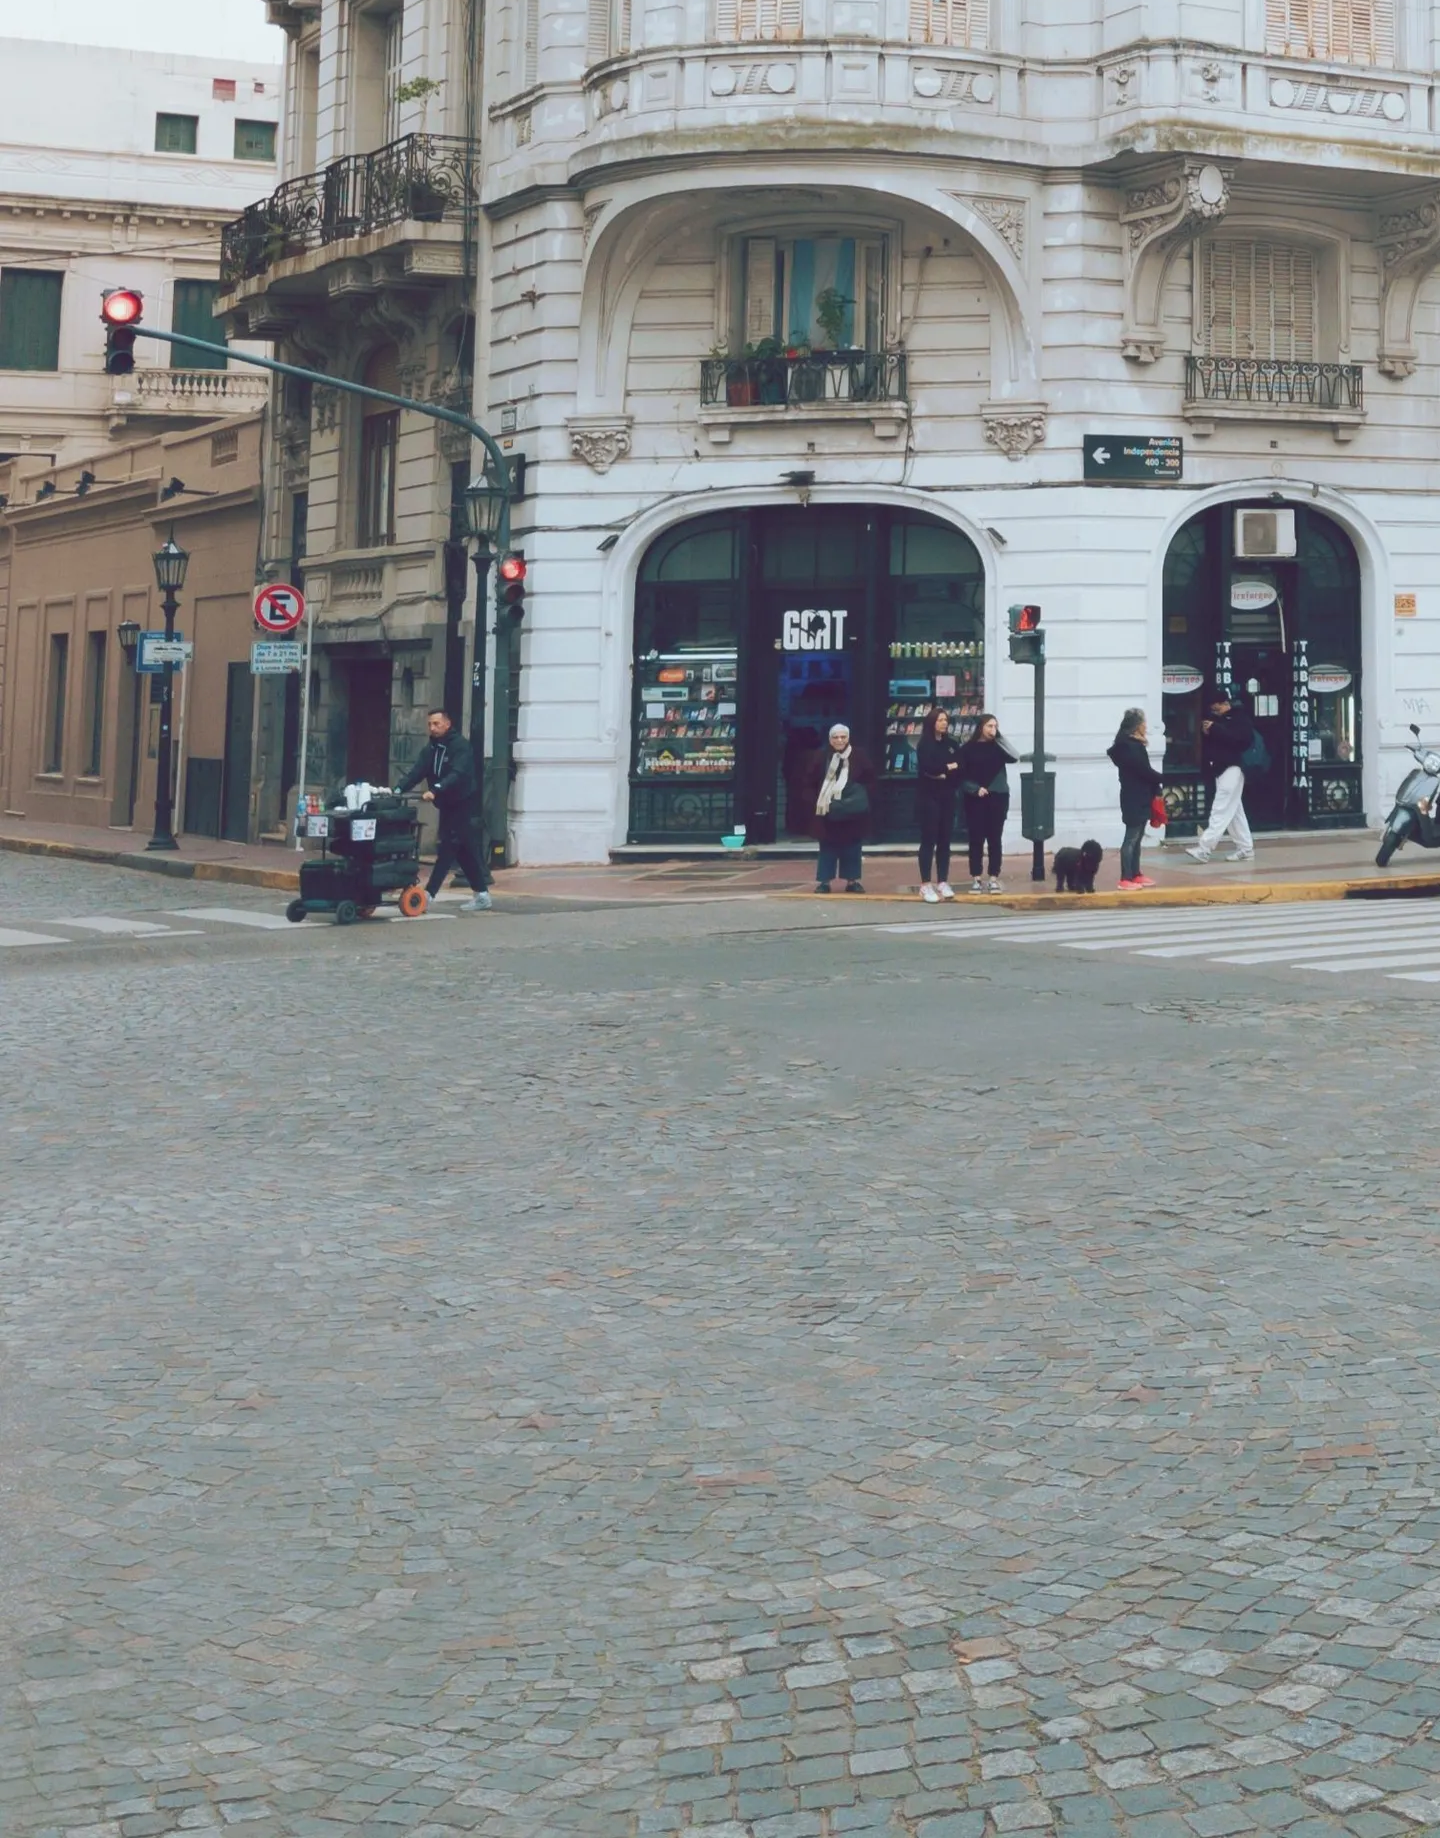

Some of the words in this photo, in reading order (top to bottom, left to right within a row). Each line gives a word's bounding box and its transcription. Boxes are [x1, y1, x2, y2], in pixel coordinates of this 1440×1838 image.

[1149, 438, 1180, 447] Avenida
[1124, 447, 1180, 456] Independencia
[1145, 458, 1160, 467] 400
[1165, 458, 1180, 467] 300
[783, 609, 848, 650] GOAT
[1300, 640, 1309, 788] TABAQUERÍA
